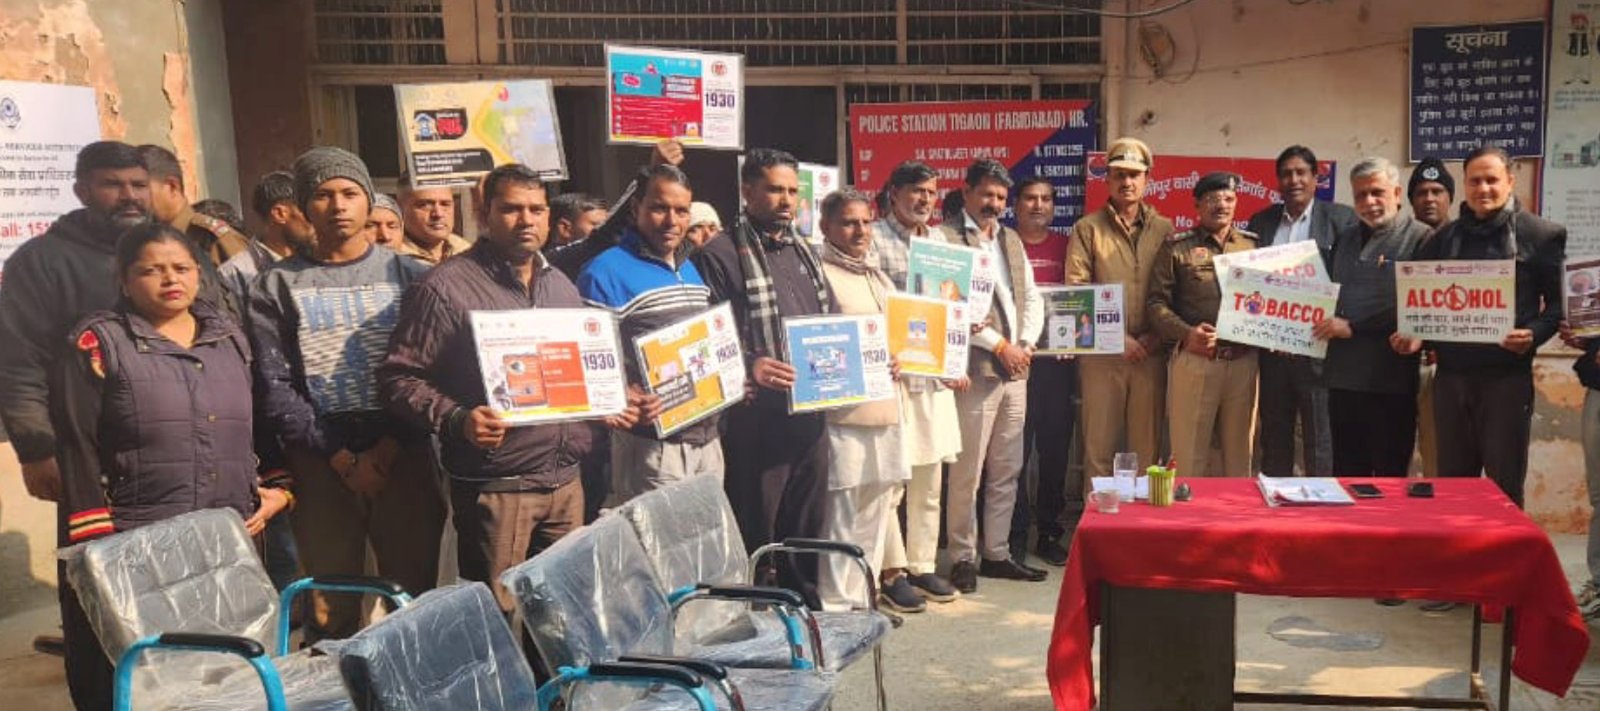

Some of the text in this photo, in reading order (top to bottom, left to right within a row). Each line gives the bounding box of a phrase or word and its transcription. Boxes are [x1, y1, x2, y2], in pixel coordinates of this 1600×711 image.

[1445, 29, 1509, 54] सूचना
[705, 92, 735, 108] 1930
[859, 109, 1088, 133] POLICE STATION TIGAON (FARIDABAD) HR.
[1455, 124, 1469, 134] IPC
[1406, 283, 1507, 311] ALCOHOL
[1096, 311, 1120, 325] 1930
[1234, 291, 1325, 325] TOBACCO
[582, 352, 616, 371] 1930
